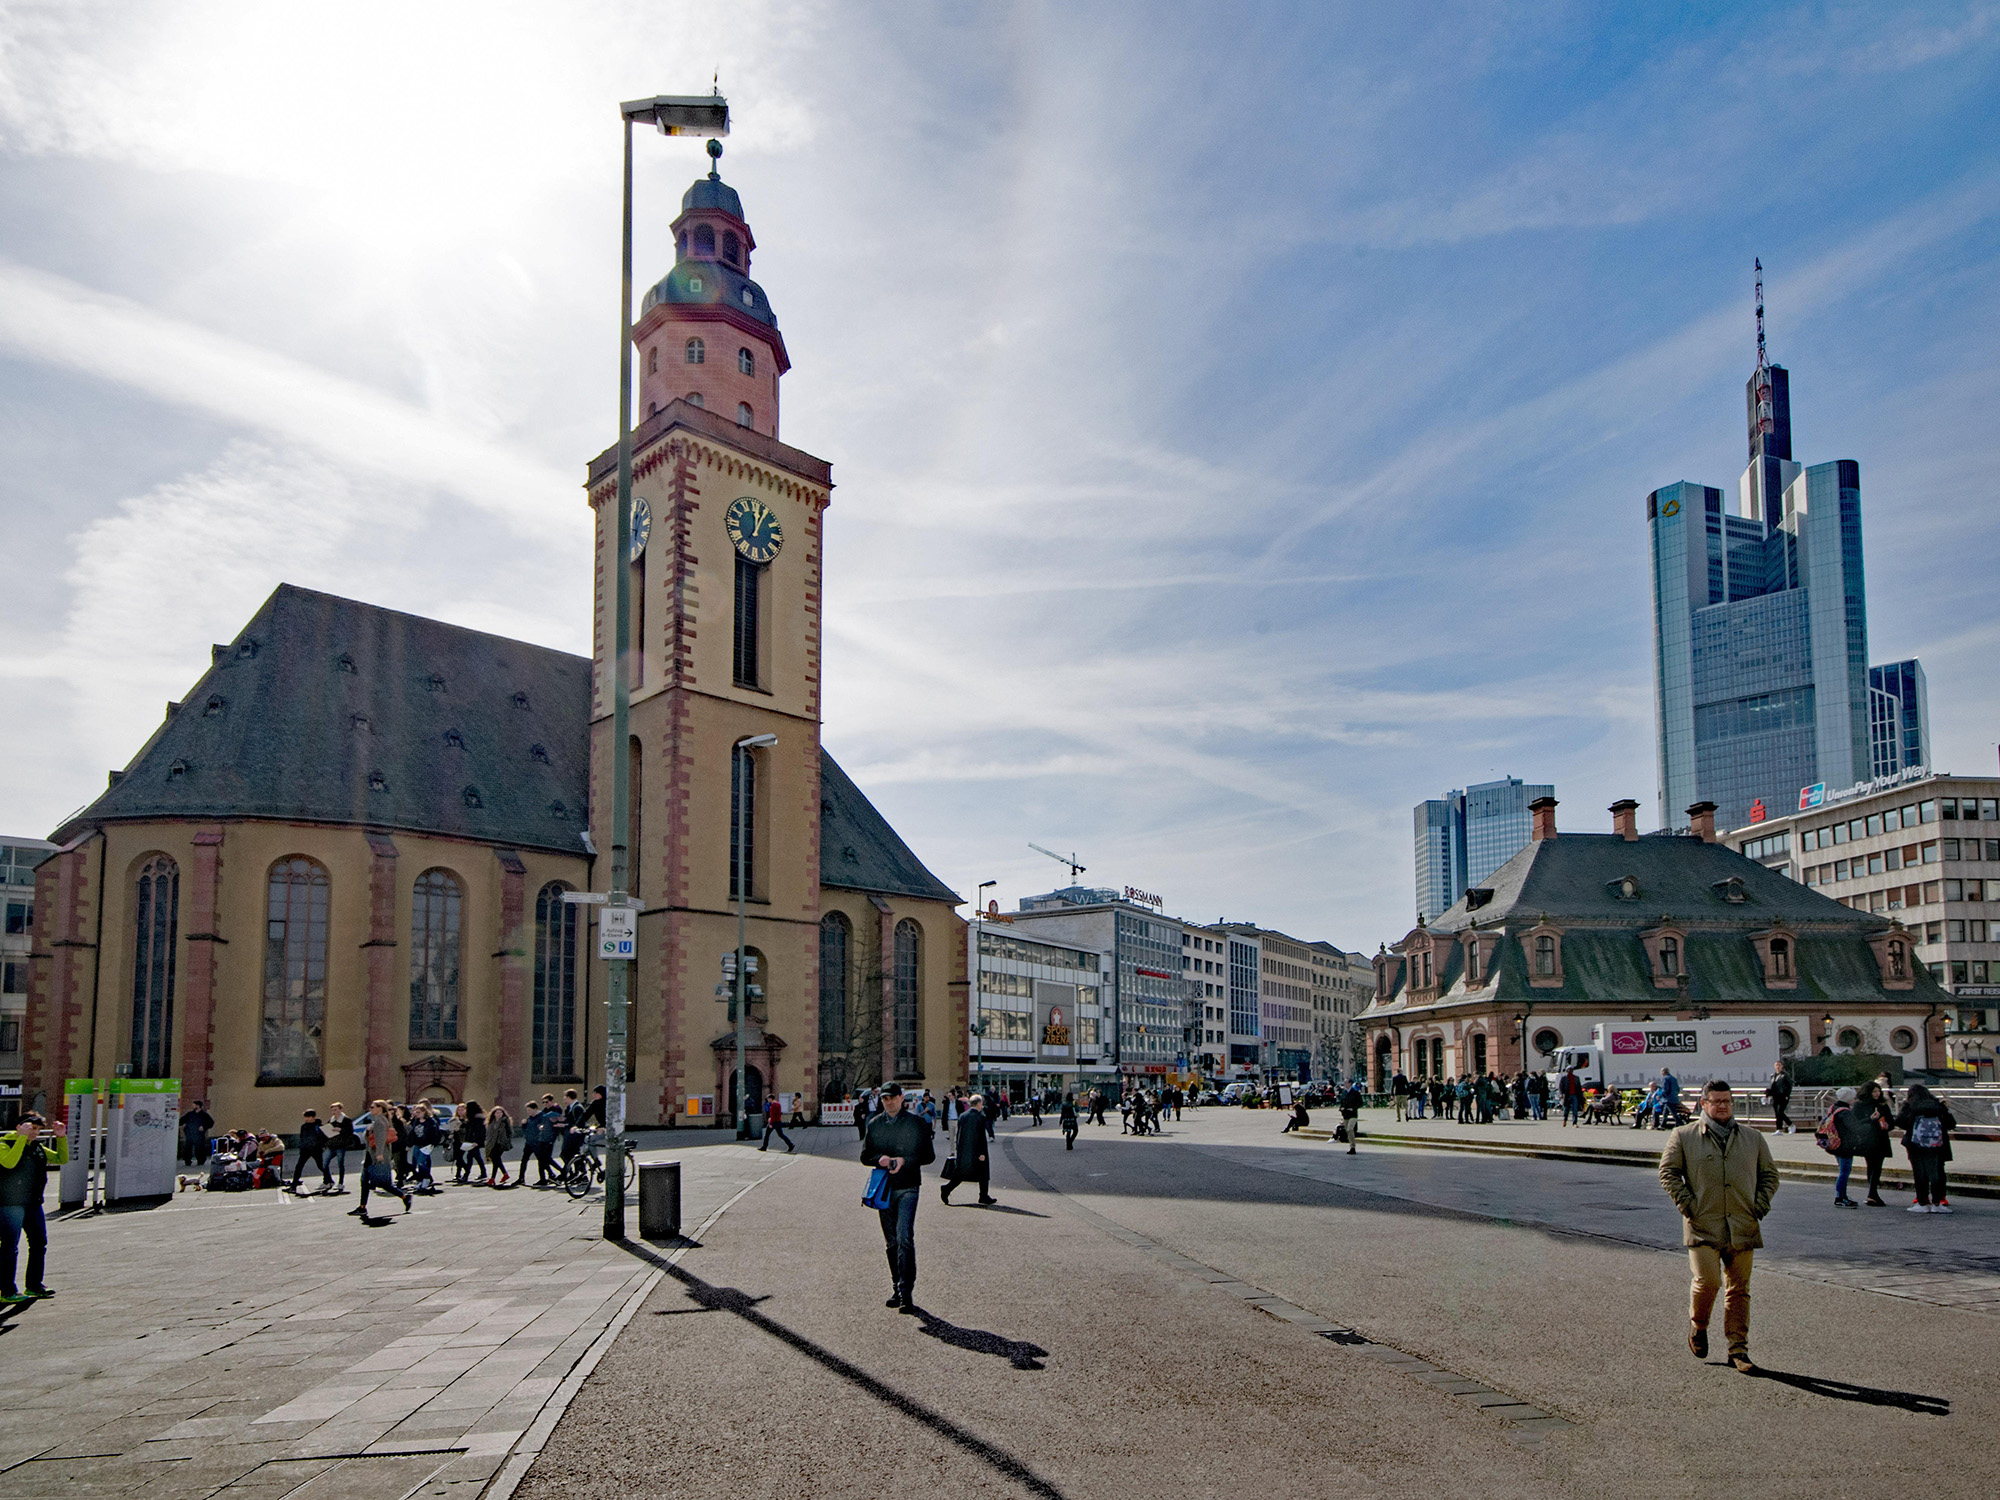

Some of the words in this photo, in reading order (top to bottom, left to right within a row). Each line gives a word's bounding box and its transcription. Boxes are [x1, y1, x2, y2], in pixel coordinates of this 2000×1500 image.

[1827, 781, 1874, 801] UnionPay
[1873, 772, 1901, 788] Your
[1901, 764, 1930, 781] Way
[1125, 885, 1163, 907] ROSSMANN
[1046, 1034, 1070, 1045] ARENA
[1649, 1033, 1695, 1047] turtle
